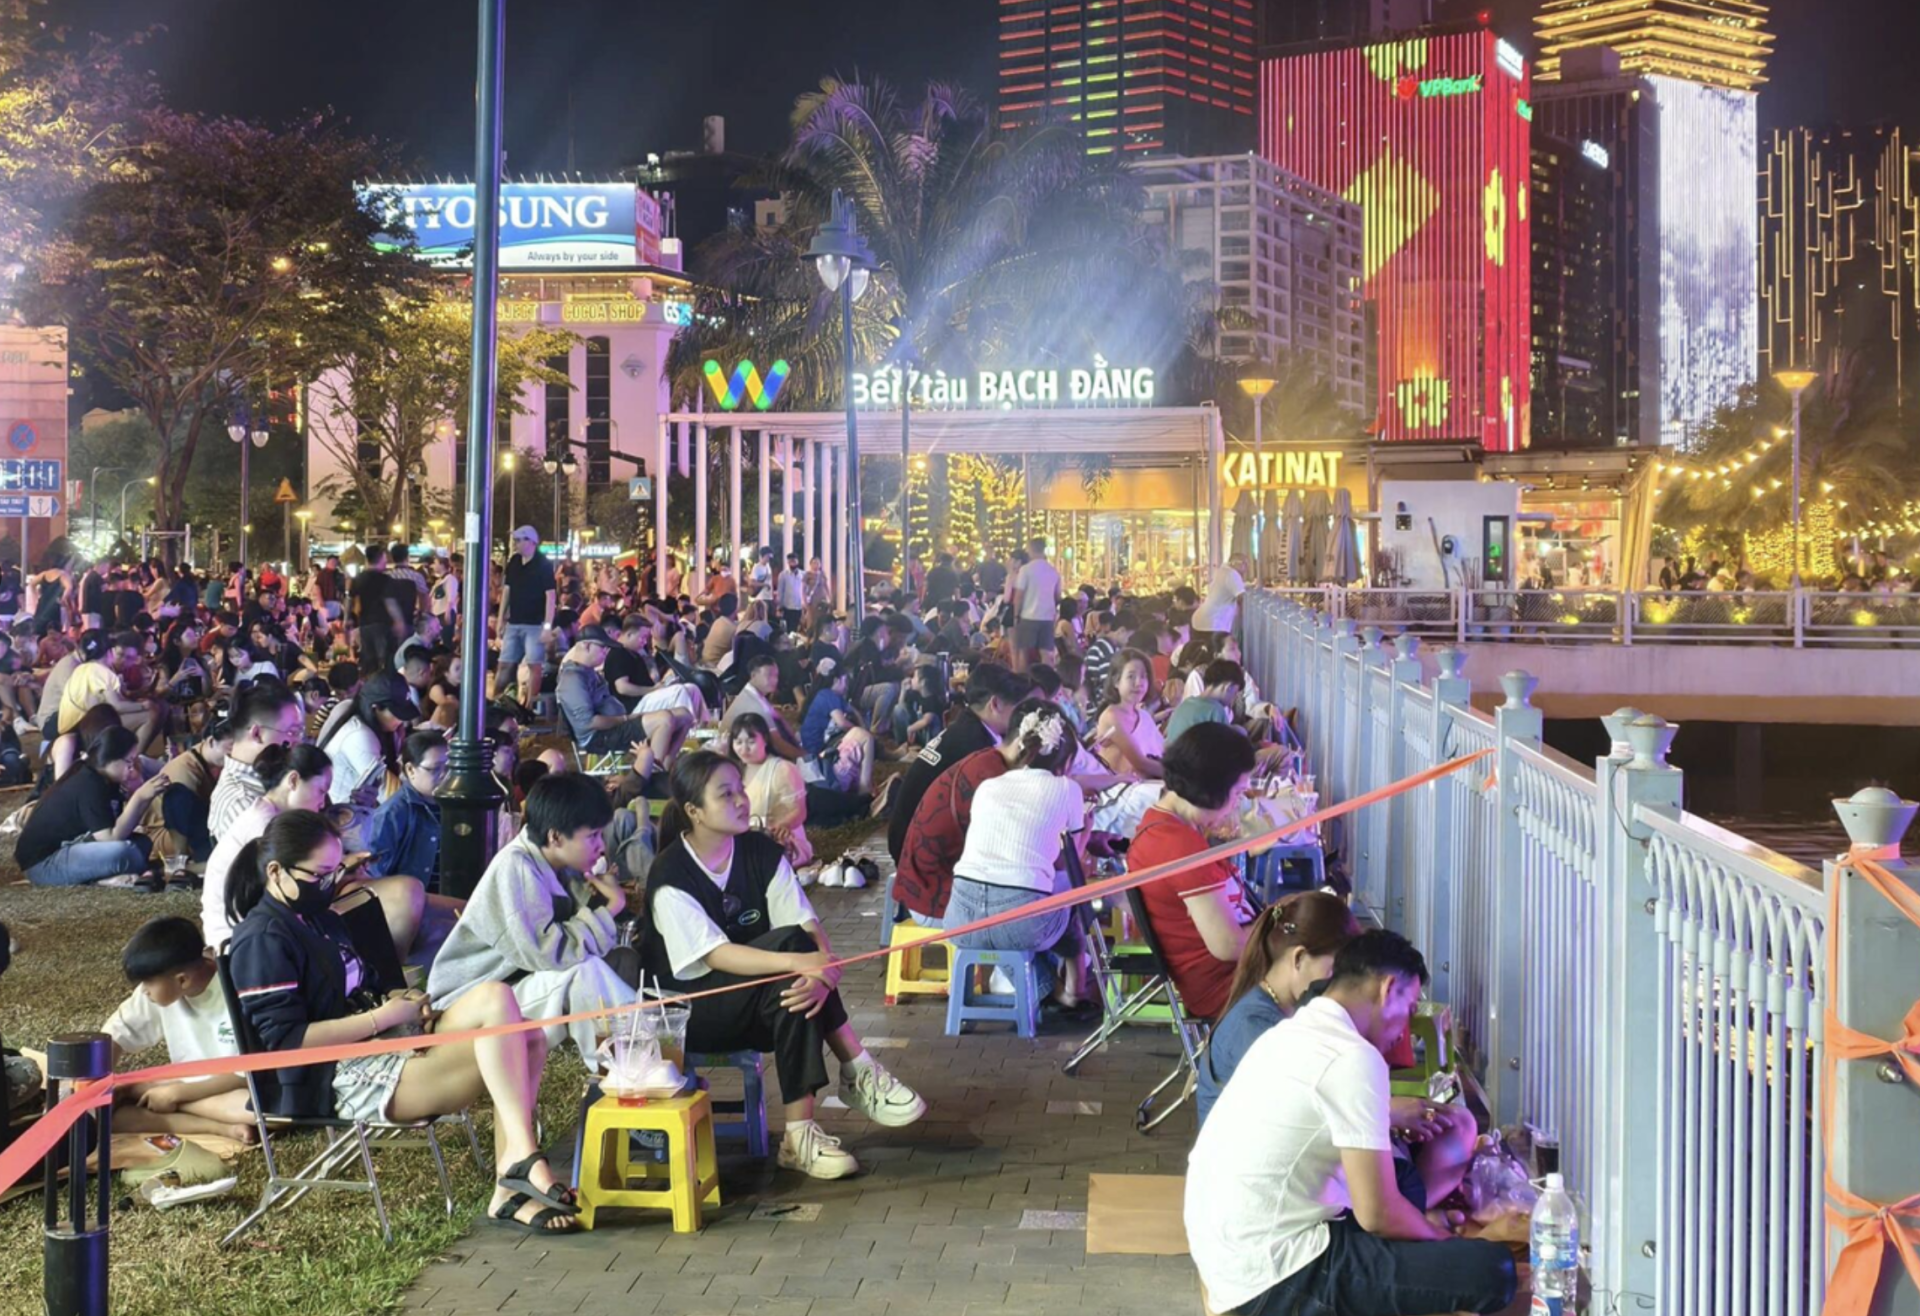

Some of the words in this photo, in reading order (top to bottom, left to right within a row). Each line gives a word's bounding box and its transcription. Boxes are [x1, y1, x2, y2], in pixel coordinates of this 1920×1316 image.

[1419, 74, 1481, 98] VPBank
[527, 250, 561, 263] Always
[563, 250, 575, 262] by
[577, 252, 598, 263] your
[599, 250, 619, 261] side
[562, 302, 606, 321] COCOA
[610, 302, 646, 321] SHOP
[921, 369, 968, 404] tàu
[979, 370, 1058, 411] BẠCH
[1069, 353, 1155, 402] ĐẰNG
[1223, 451, 1343, 488] KATINAT
